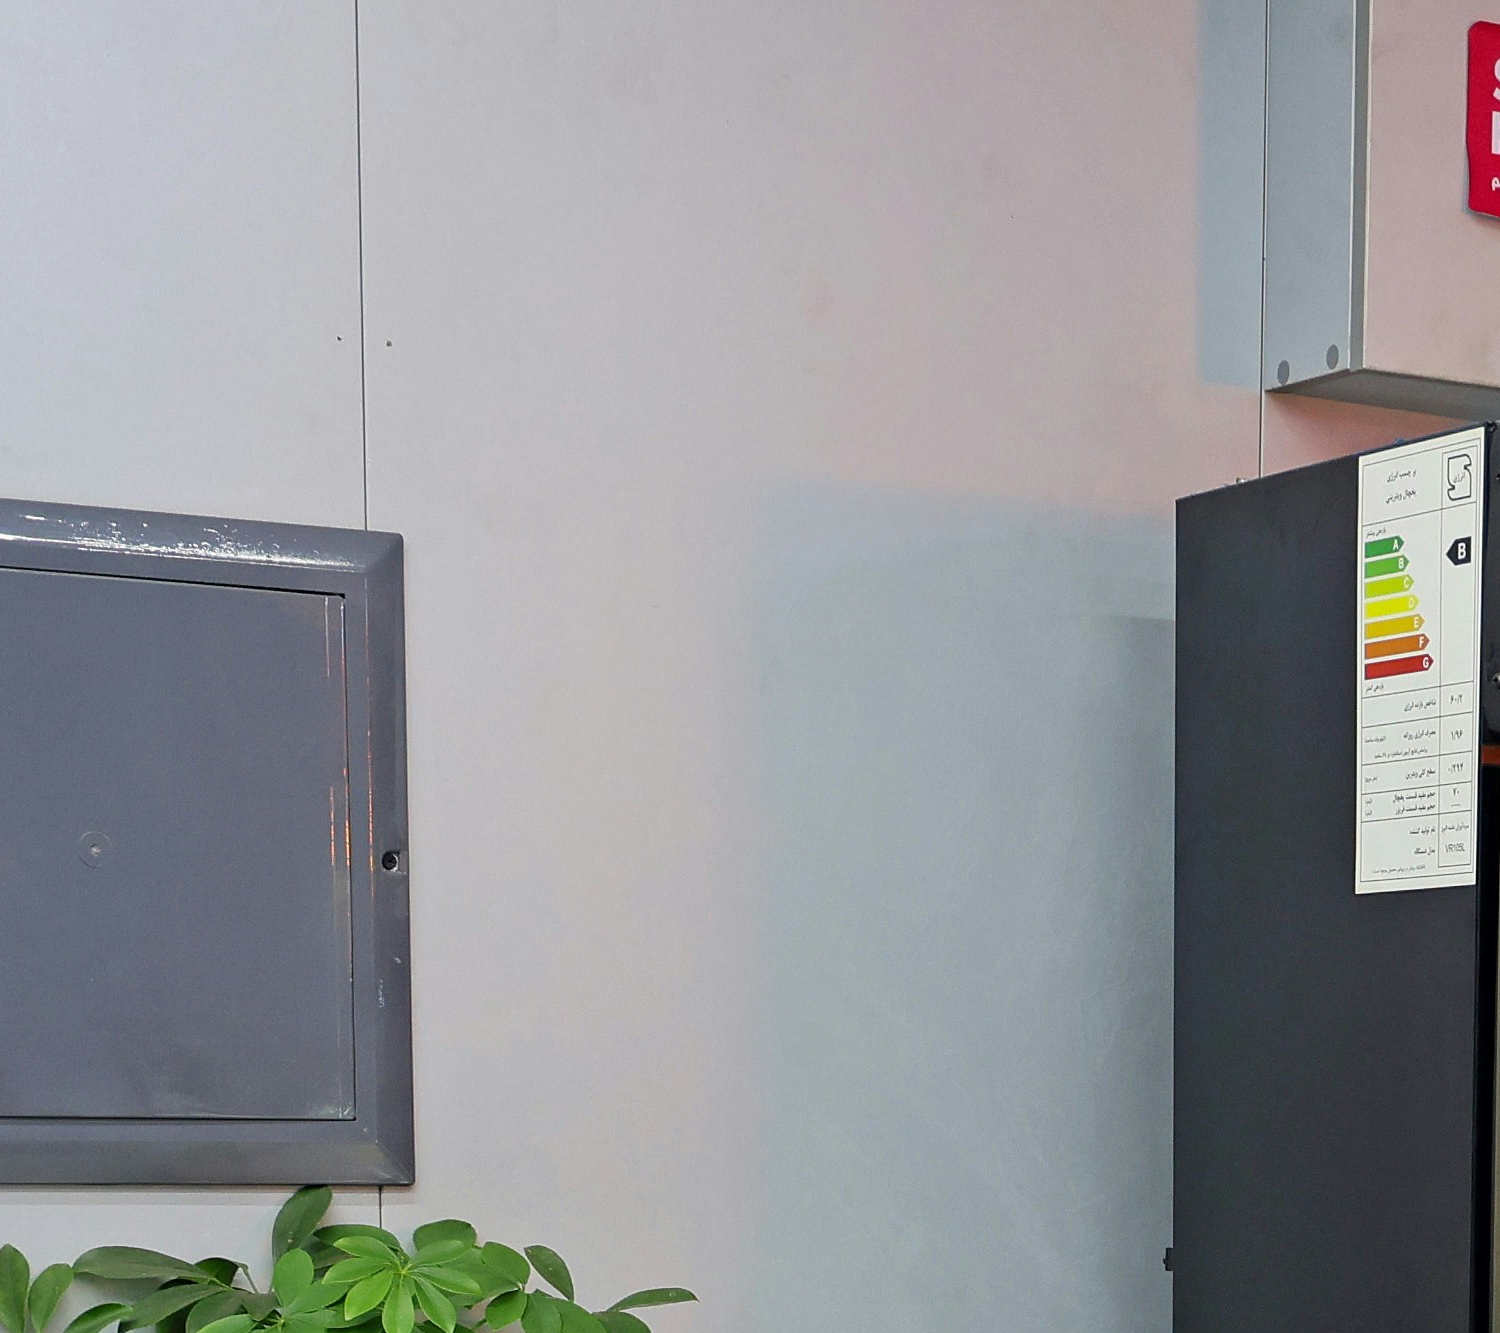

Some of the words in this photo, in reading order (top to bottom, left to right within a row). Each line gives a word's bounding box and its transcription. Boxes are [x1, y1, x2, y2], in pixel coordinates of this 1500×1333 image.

[1392, 539, 1399, 550] A
[1457, 542, 1467, 560] B
[1398, 557, 1405, 569] B
[1404, 577, 1409, 588] C
[1408, 597, 1414, 608] D
[1413, 616, 1419, 628] E
[1419, 636, 1424, 648] F
[1422, 656, 1429, 669] G
